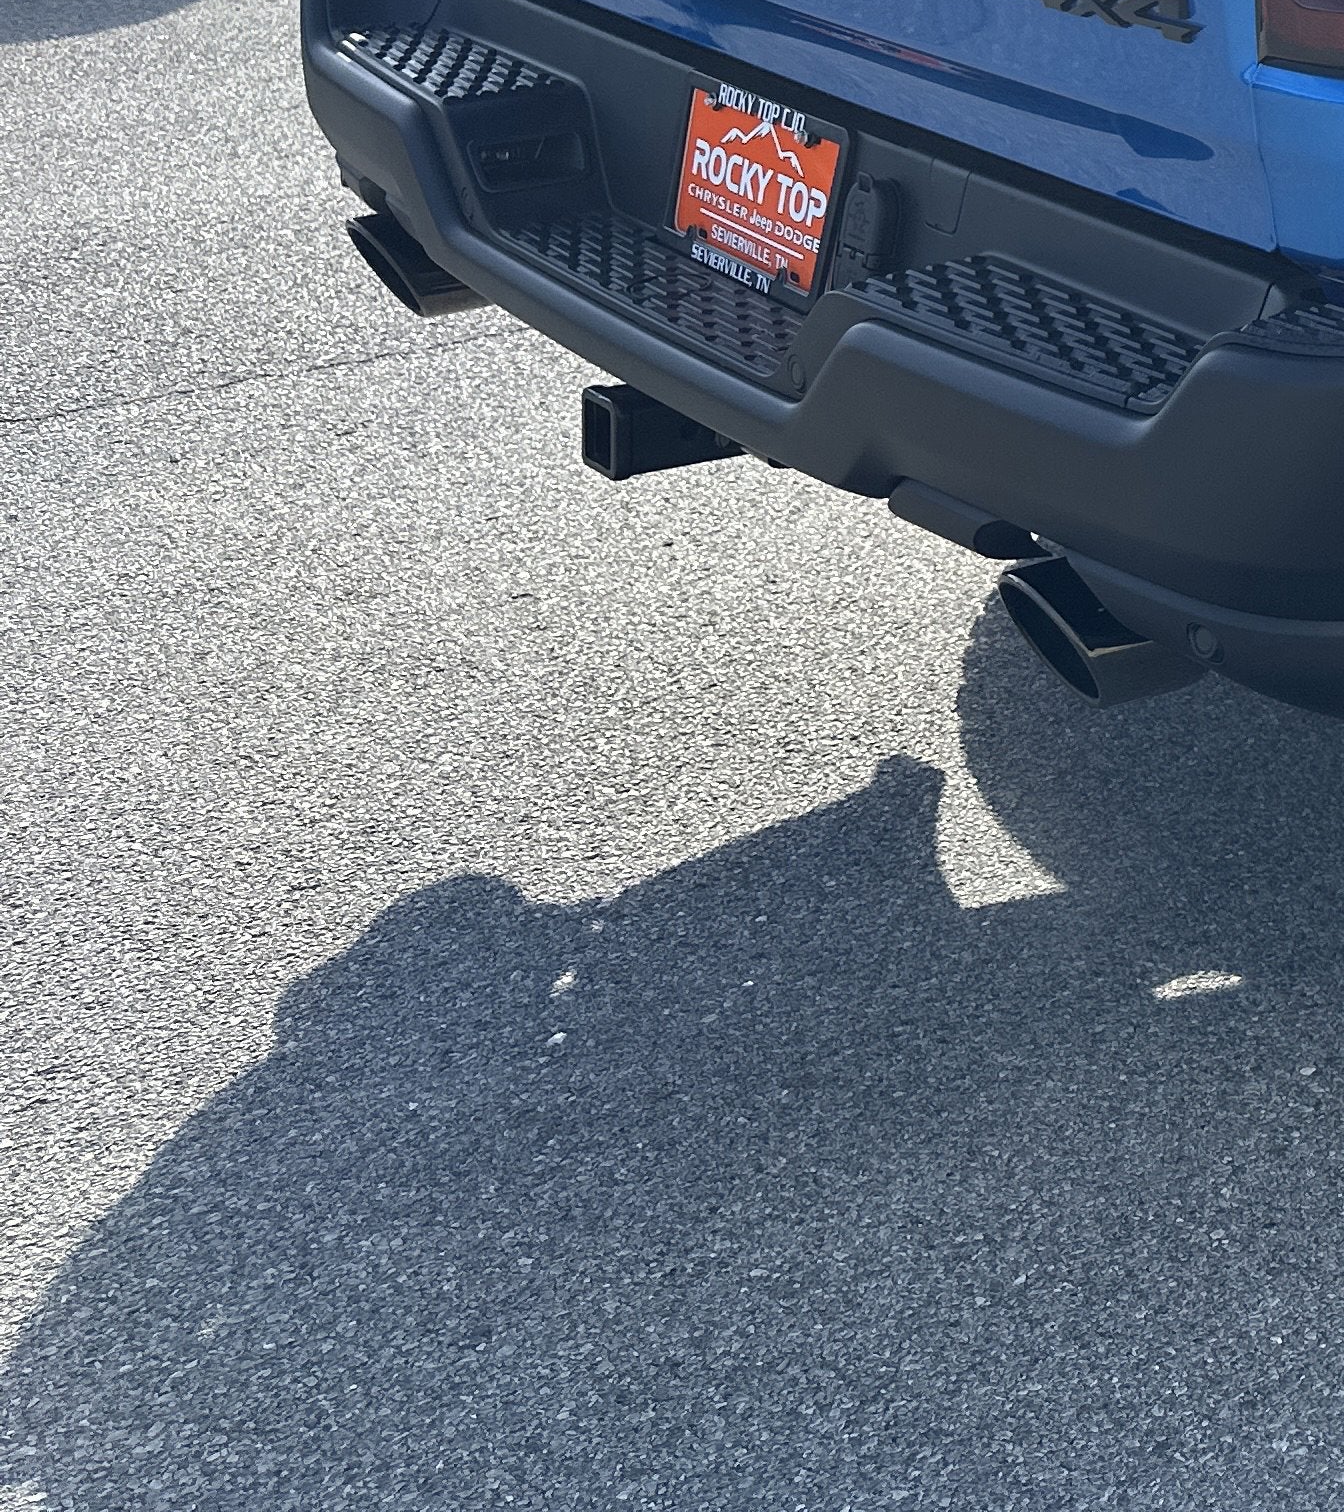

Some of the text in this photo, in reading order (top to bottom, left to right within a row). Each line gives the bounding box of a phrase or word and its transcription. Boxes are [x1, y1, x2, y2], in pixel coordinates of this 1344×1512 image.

[718, 84, 754, 115] ROCKY
[758, 98, 780, 124] TOP
[692, 138, 828, 228] ROCKY TOP
[688, 183, 821, 254] CHRYSLER Jeep DODGE
[691, 244, 771, 294] SEVIERVILLE, TN
[711, 224, 789, 270] SEVIERVILLE, TN
